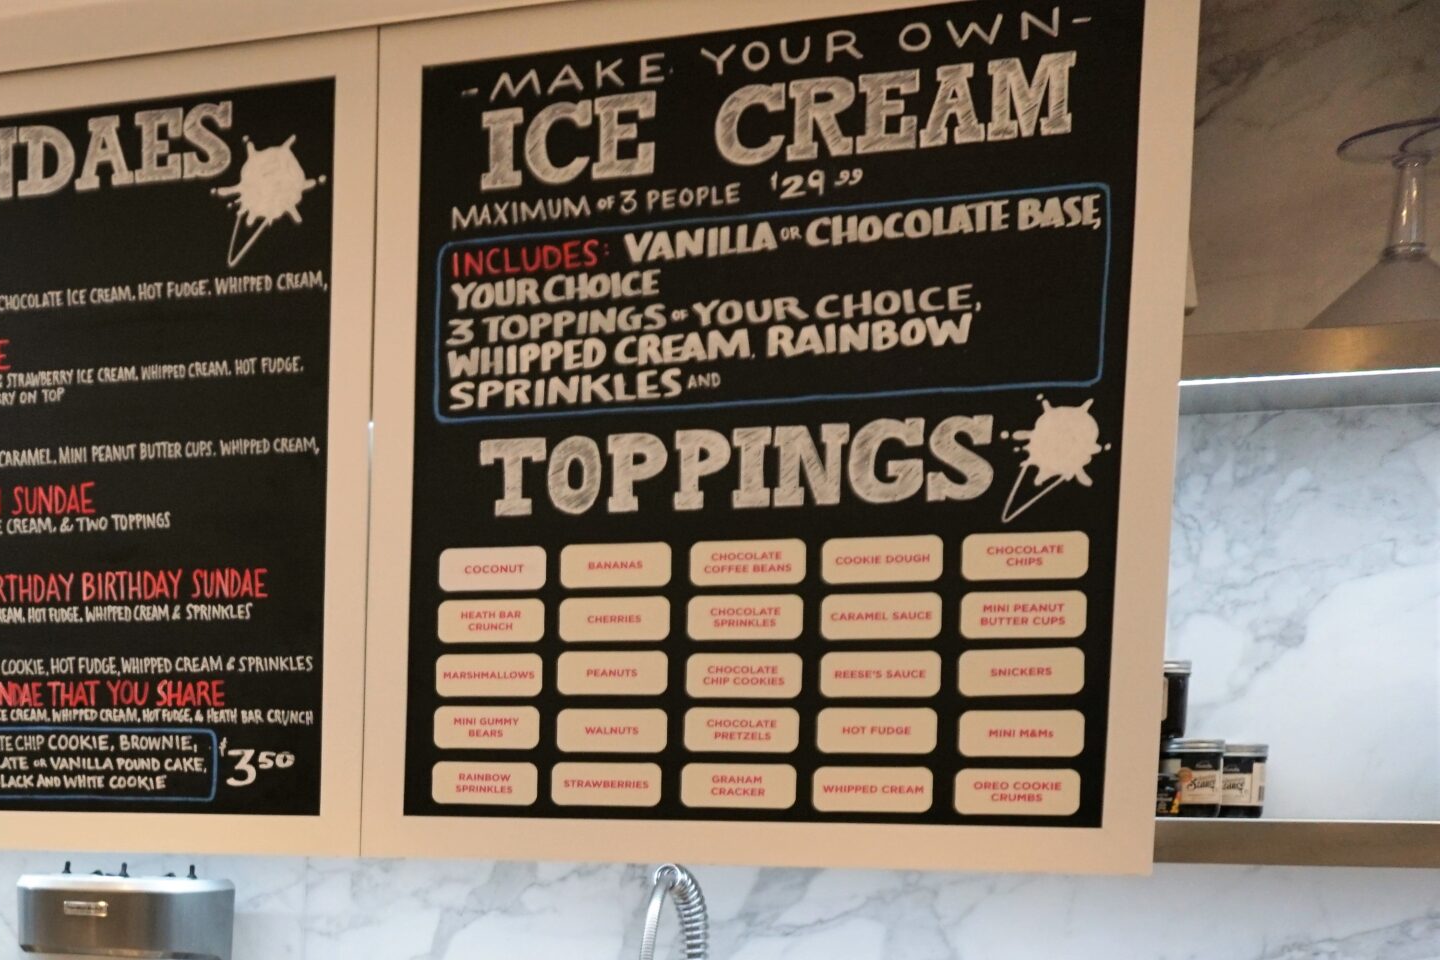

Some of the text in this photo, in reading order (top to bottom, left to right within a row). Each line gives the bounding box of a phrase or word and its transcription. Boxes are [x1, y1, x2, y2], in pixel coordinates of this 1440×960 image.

[701, 30, 863, 76] YOUR
[481, 51, 1077, 191] ICE CREAM
[452, 195, 590, 231] MAXIMUM
[620, 189, 637, 213] 3
[647, 183, 741, 211] PEOPLE
[624, 221, 778, 264] VANILLA
[806, 199, 1010, 247] CHOCOLATE
[451, 269, 661, 310] YOUR CHOICE
[446, 319, 474, 345] 3
[482, 303, 667, 343] TOPPINGS
[693, 296, 809, 327] YOUR
[816, 283, 981, 319] CHOICE,
[447, 337, 606, 378] WHIPPED
[766, 313, 973, 357] RAINBOW
[449, 367, 721, 411] SPRINKLES AND
[480, 414, 994, 517] TOPPINGS
[12, 481, 95, 515] SUNDAE
[987, 544, 1064, 555] CHOCOLATE
[711, 551, 782, 562] CHOCOLATE
[835, 554, 930, 566] COOKIE DOUGH
[1006, 556, 1043, 566] CHIPS
[464, 564, 525, 575] COCONUT
[588, 561, 643, 571] BANANAS
[704, 562, 792, 574] COFFEE BEANS
[82, 568, 183, 601] BIRTHDAY
[191, 568, 269, 598] SUNDAE
[710, 607, 781, 617] CHOCOLATE
[983, 603, 1065, 613] MINI PEANUT
[461, 610, 521, 620] HEATH BAR
[587, 615, 642, 624] CHERRIES
[830, 610, 932, 621] CARAMEL SAUCE
[714, 618, 776, 628] SPRINKLES
[980, 616, 1065, 626] BUTTER CUPS
[468, 622, 513, 632] CRUNCH
[586, 669, 638, 677] PEANUTS
[707, 665, 778, 674] CHOCOLATE
[835, 669, 926, 679] REESE'S SAUCE
[991, 667, 1052, 677] SNICKERS
[443, 671, 535, 680] MARSHMALLOWS
[703, 677, 785, 686] CHIP COOKIES
[454, 717, 519, 726] MINI GUMMY
[468, 728, 503, 737] BEARS
[585, 726, 639, 735] WALNUTS
[842, 726, 911, 735] HOT FUDGE
[564, 780, 649, 789] STRAWBERRIES
[823, 784, 924, 794] WHIPPED CREAM
